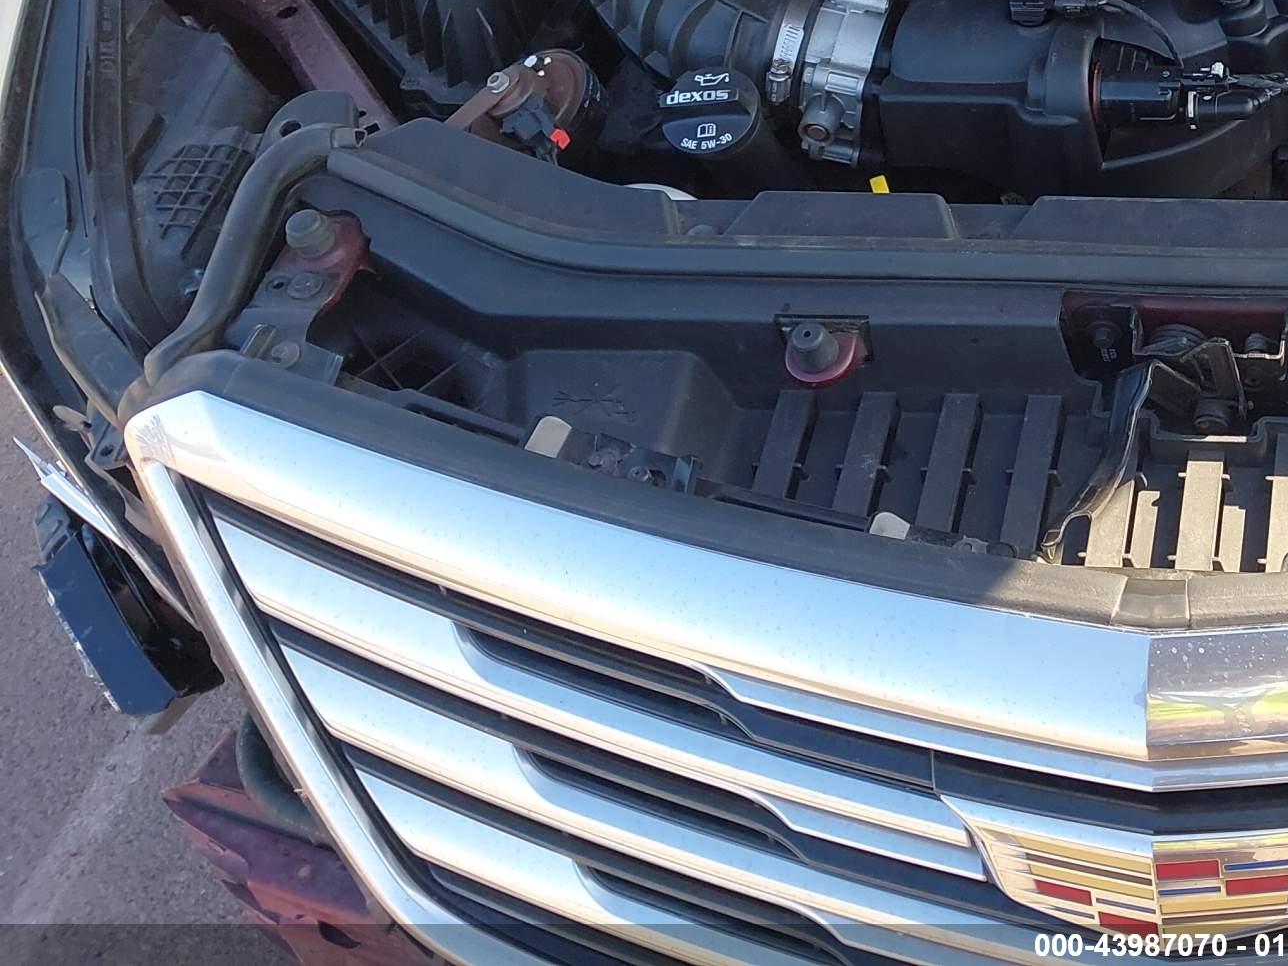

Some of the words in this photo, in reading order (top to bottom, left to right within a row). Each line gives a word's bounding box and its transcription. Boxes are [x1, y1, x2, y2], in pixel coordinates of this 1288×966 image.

[666, 90, 731, 105] dexos
[680, 137, 699, 151] SAE
[700, 132, 733, 150] 5W-30
